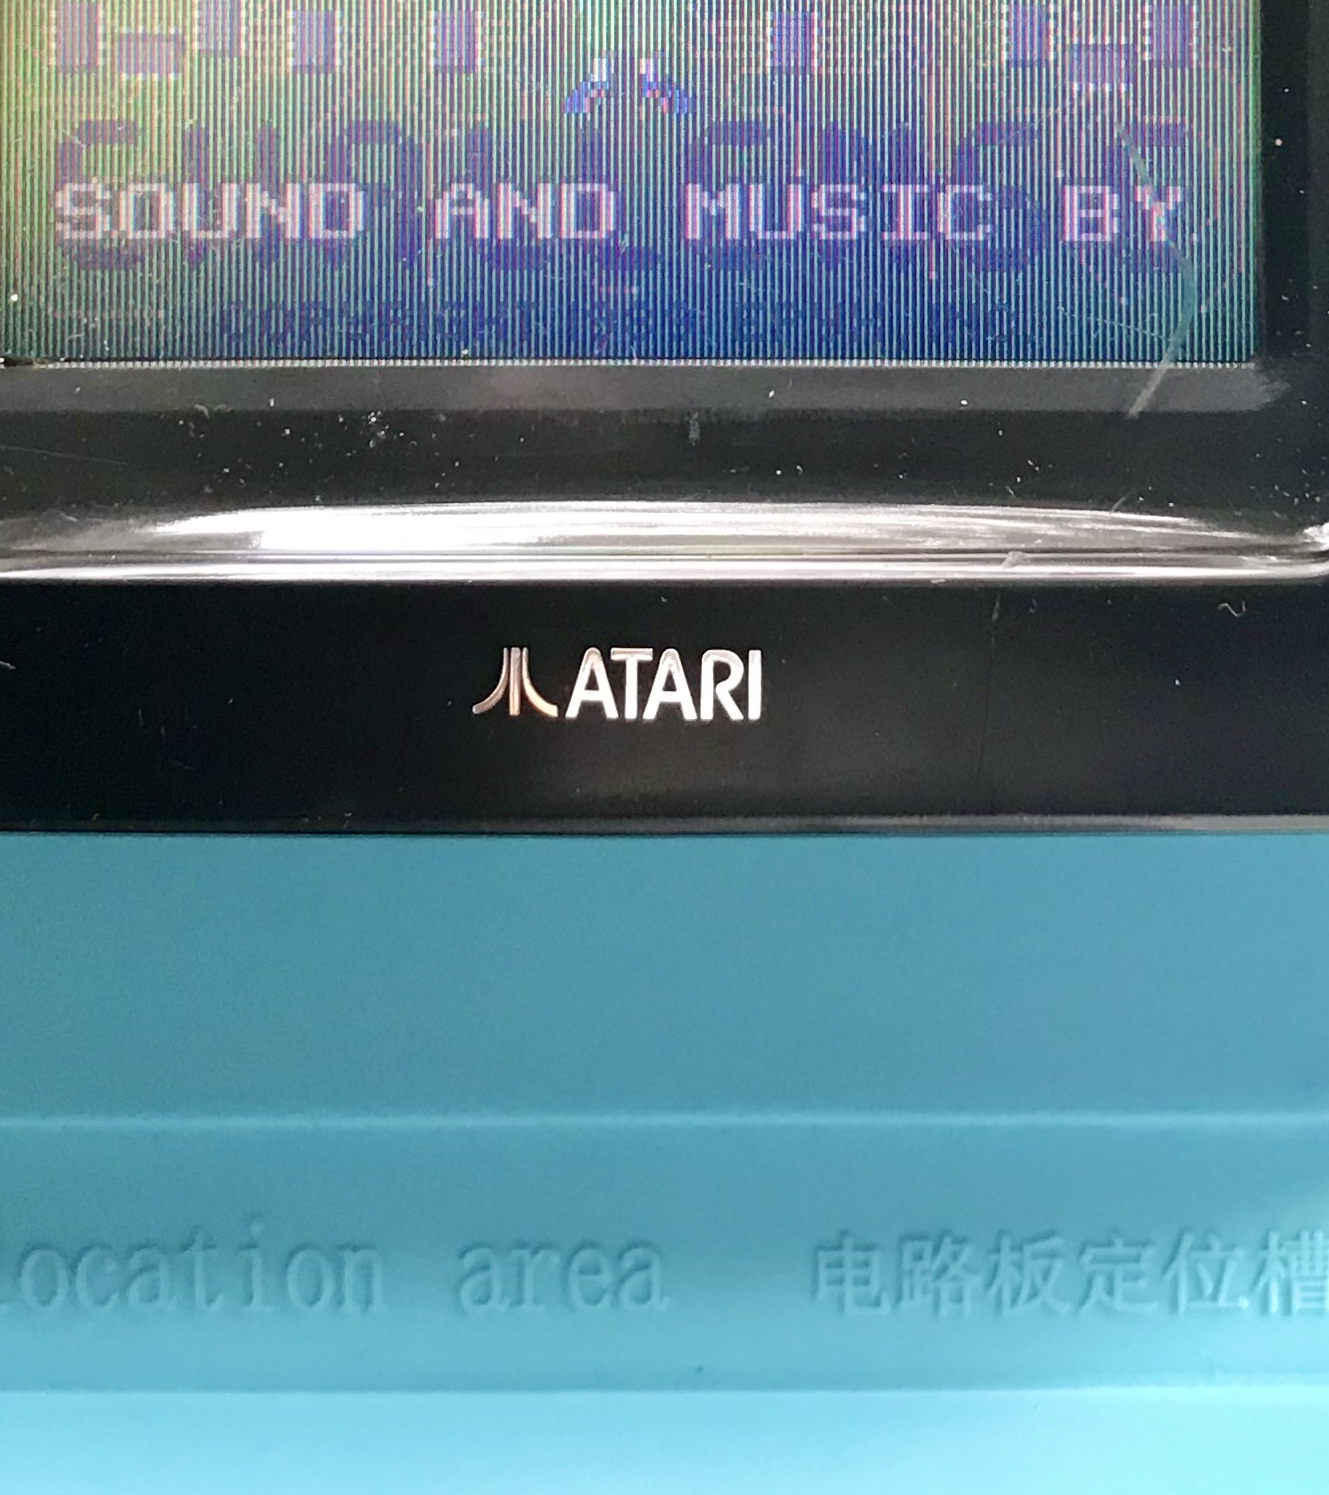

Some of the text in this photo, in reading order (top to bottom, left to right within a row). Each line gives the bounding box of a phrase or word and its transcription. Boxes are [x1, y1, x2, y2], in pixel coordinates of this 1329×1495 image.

[56, 183, 1187, 243] SOUND AND MUSIC BY
[565, 646, 762, 720] ATARI
[457, 1240, 672, 1312] area
